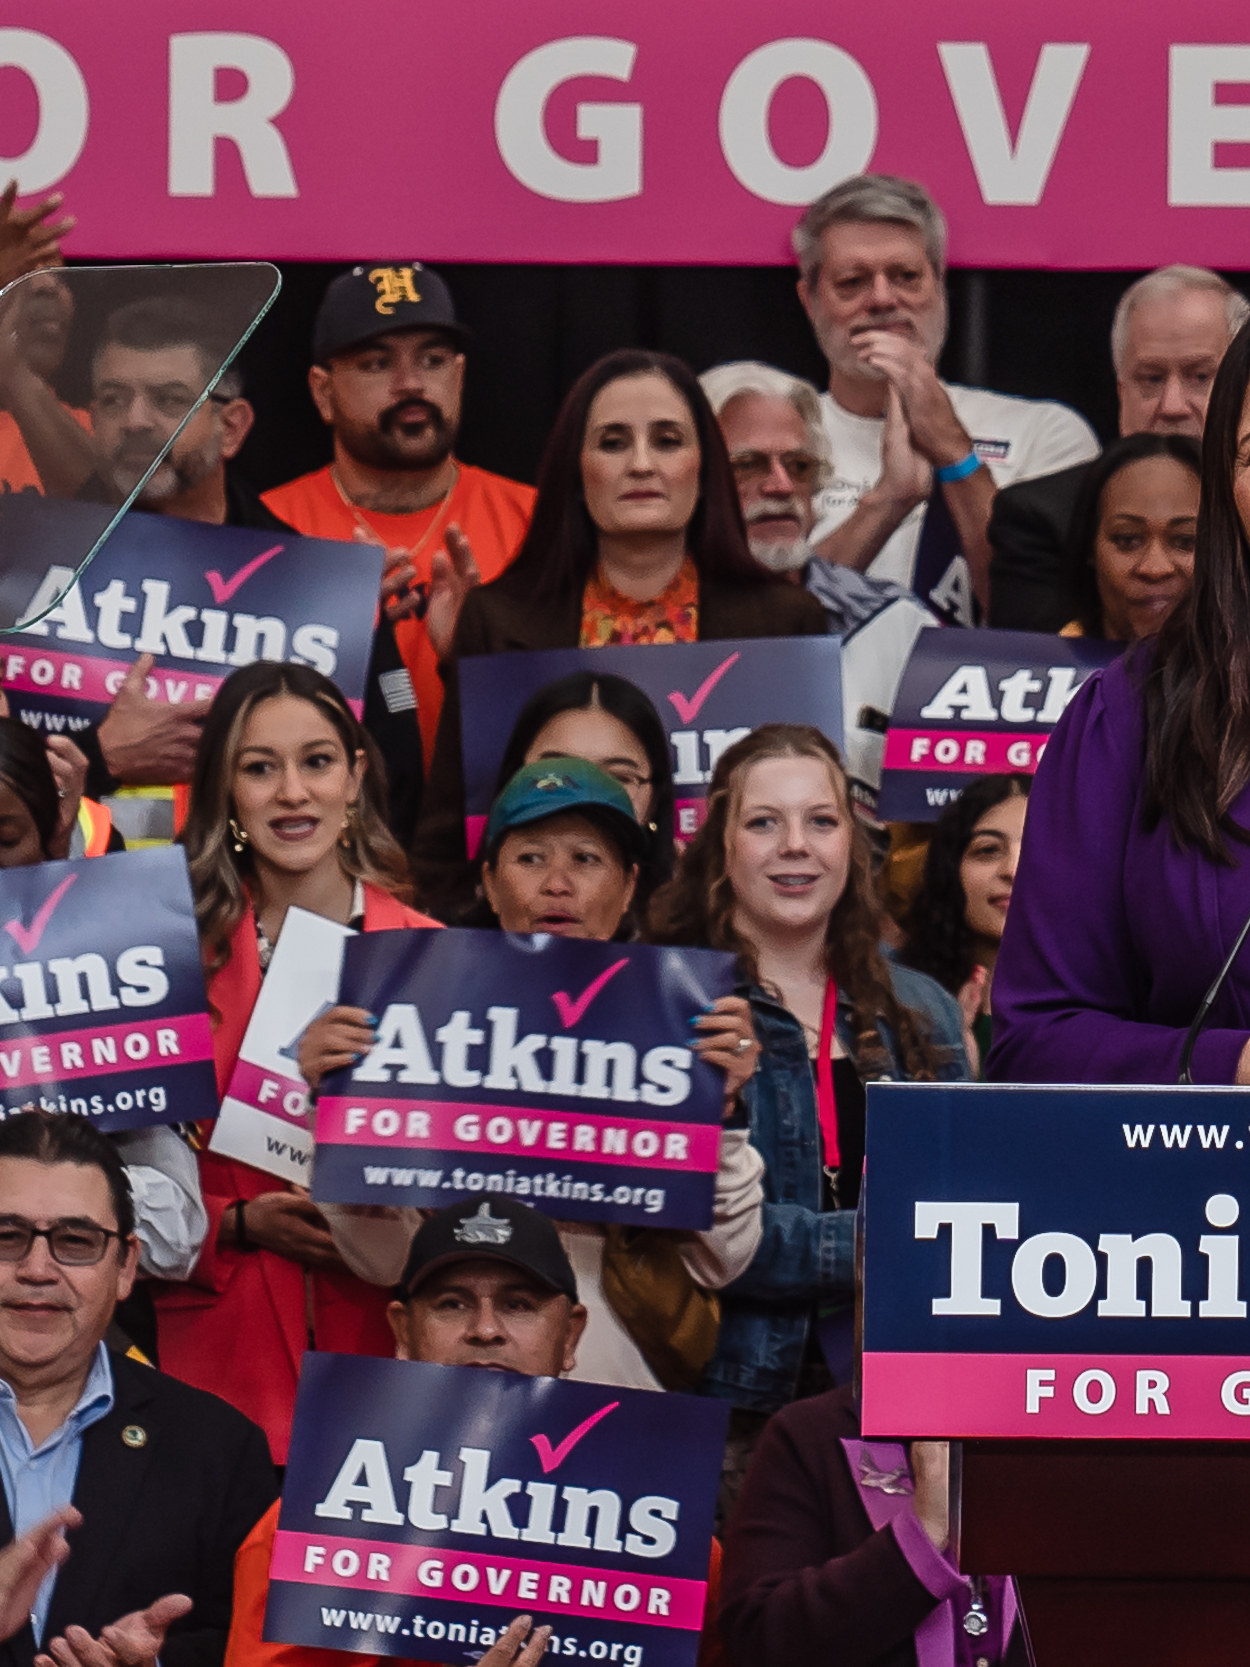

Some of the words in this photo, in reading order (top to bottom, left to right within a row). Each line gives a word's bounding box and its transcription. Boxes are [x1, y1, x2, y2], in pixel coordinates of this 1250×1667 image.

[14, 564, 341, 678] Atkins
[5, 654, 83, 691] FOR
[909, 737, 987, 767] FOR
[352, 1003, 693, 1107] Atkins
[345, 1107, 431, 1139] FOR
[453, 1114, 689, 1161] GOVERNOR
[363, 1165, 666, 1213] www.toniatkins.org
[914, 1193, 1248, 1320] Toni
[1025, 1368, 1173, 1416] FOR
[314, 1438, 680, 1559] Atkins
[302, 1544, 392, 1581] FOR
[417, 1558, 672, 1617] GOVERNOR
